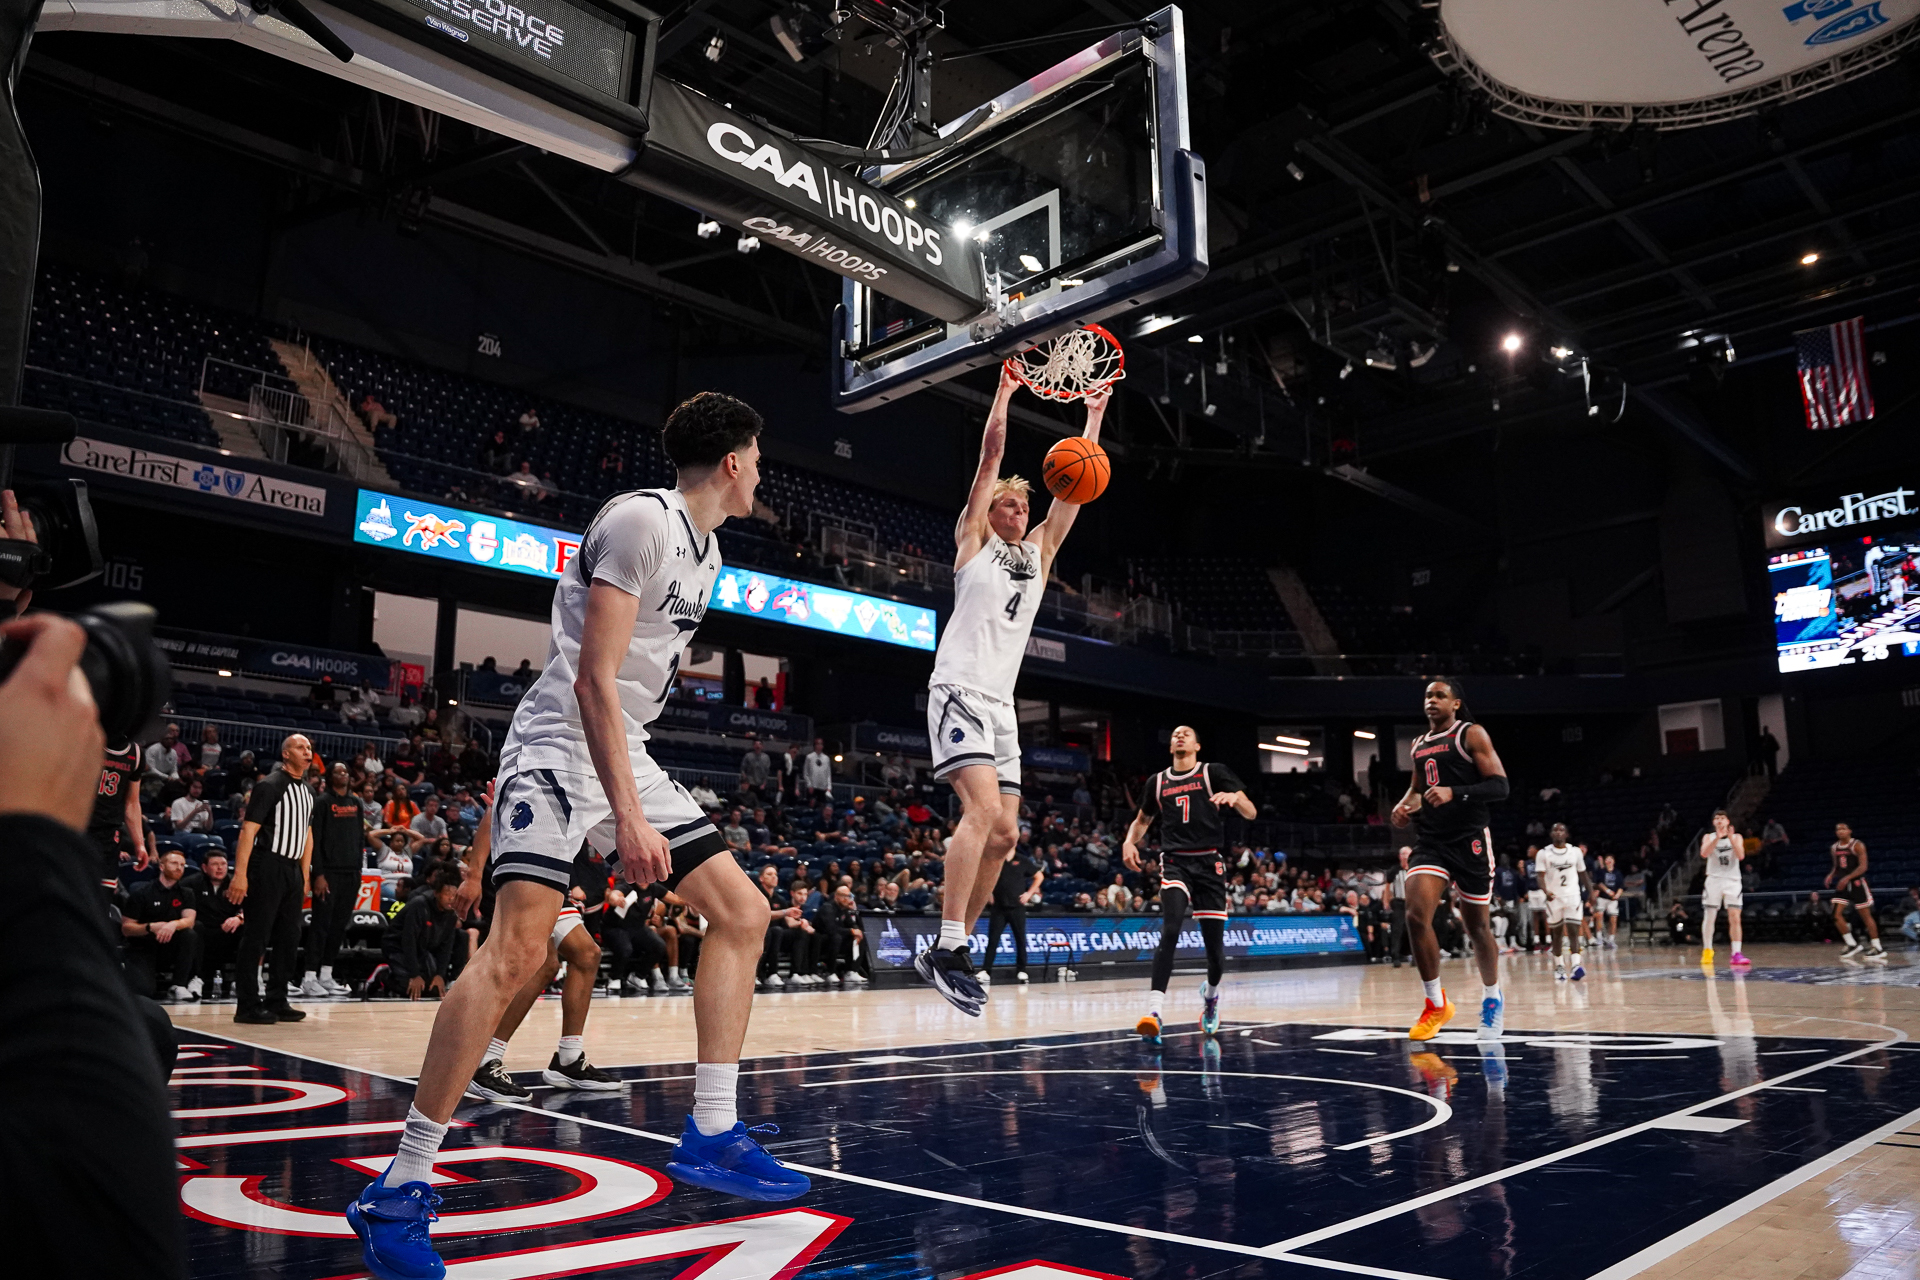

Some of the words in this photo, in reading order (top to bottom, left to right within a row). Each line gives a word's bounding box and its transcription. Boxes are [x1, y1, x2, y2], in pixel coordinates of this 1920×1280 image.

[441, 22, 466, 39] Wagner
[481, 0, 564, 46] ORCE
[707, 122, 822, 204] CAA
[832, 179, 942, 266] HOOPS
[742, 216, 813, 253] CAA
[812, 240, 887, 281] HOOPS
[478, 335, 502, 358] 204
[63, 439, 188, 485] CareFirst
[247, 475, 322, 514] Arena
[1775, 487, 1915, 537] CareFirst
[0, 552, 23, 563] anon
[991, 549, 1037, 574] Hawks
[103, 561, 144, 591] 105
[1004, 591, 1022, 622] 4
[270, 651, 311, 669] CAA
[315, 656, 359, 677] HOOPS
[98, 769, 121, 797] 13
[1424, 758, 1440, 787] 0
[1162, 781, 1203, 797] CAMPBELL
[1174, 794, 1191, 824] 7
[353, 914, 380, 925] CAA
[1090, 931, 1126, 951] CAA
[1252, 927, 1338, 946] CHAMPIONSHIP
